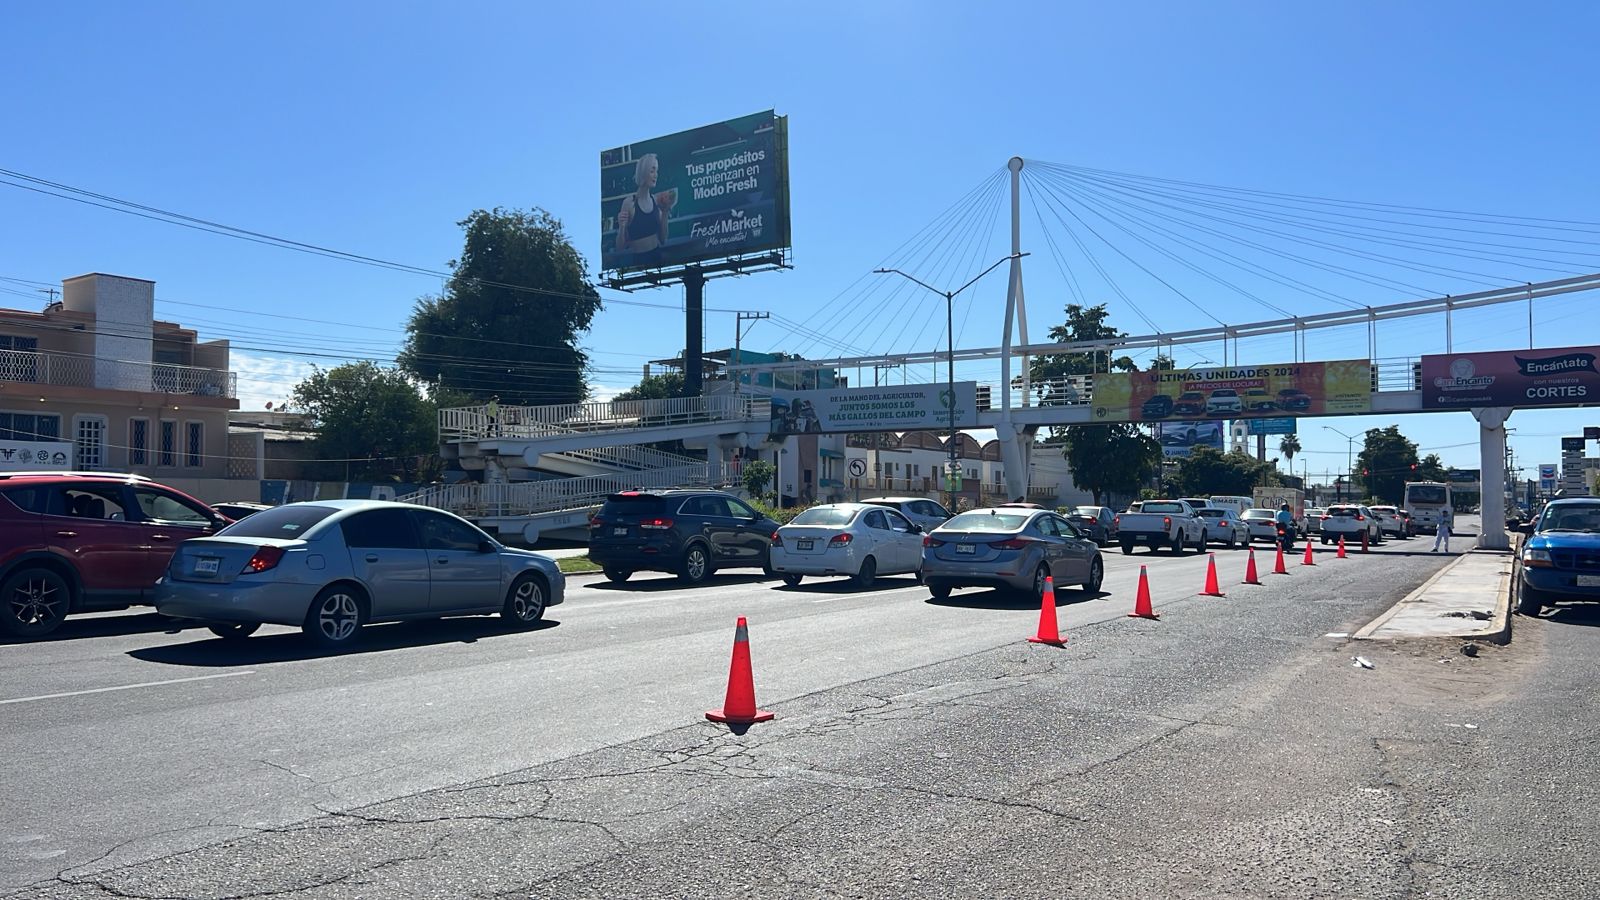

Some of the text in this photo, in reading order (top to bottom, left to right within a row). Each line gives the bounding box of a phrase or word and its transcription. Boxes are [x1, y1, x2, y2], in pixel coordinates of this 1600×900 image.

[685, 150, 765, 176] Tus propósitos
[691, 164, 760, 188] comienzan en
[693, 176, 757, 200] Modo Fresh
[1527, 357, 1588, 373] Encántate
[1206, 368, 1270, 380] UNIDADES
[1273, 367, 1300, 377] 2024
[1195, 382, 1221, 390] PRECIOS
[1526, 385, 1587, 399] CORTES
[848, 394, 869, 402] MANO
[869, 393, 880, 401] DEL
[882, 391, 926, 400] AGRICULTOR,
[839, 400, 916, 412] JUNTOS SOMOS LOS
[828, 409, 926, 421] MÁS GALLOS DEL CAMPO
